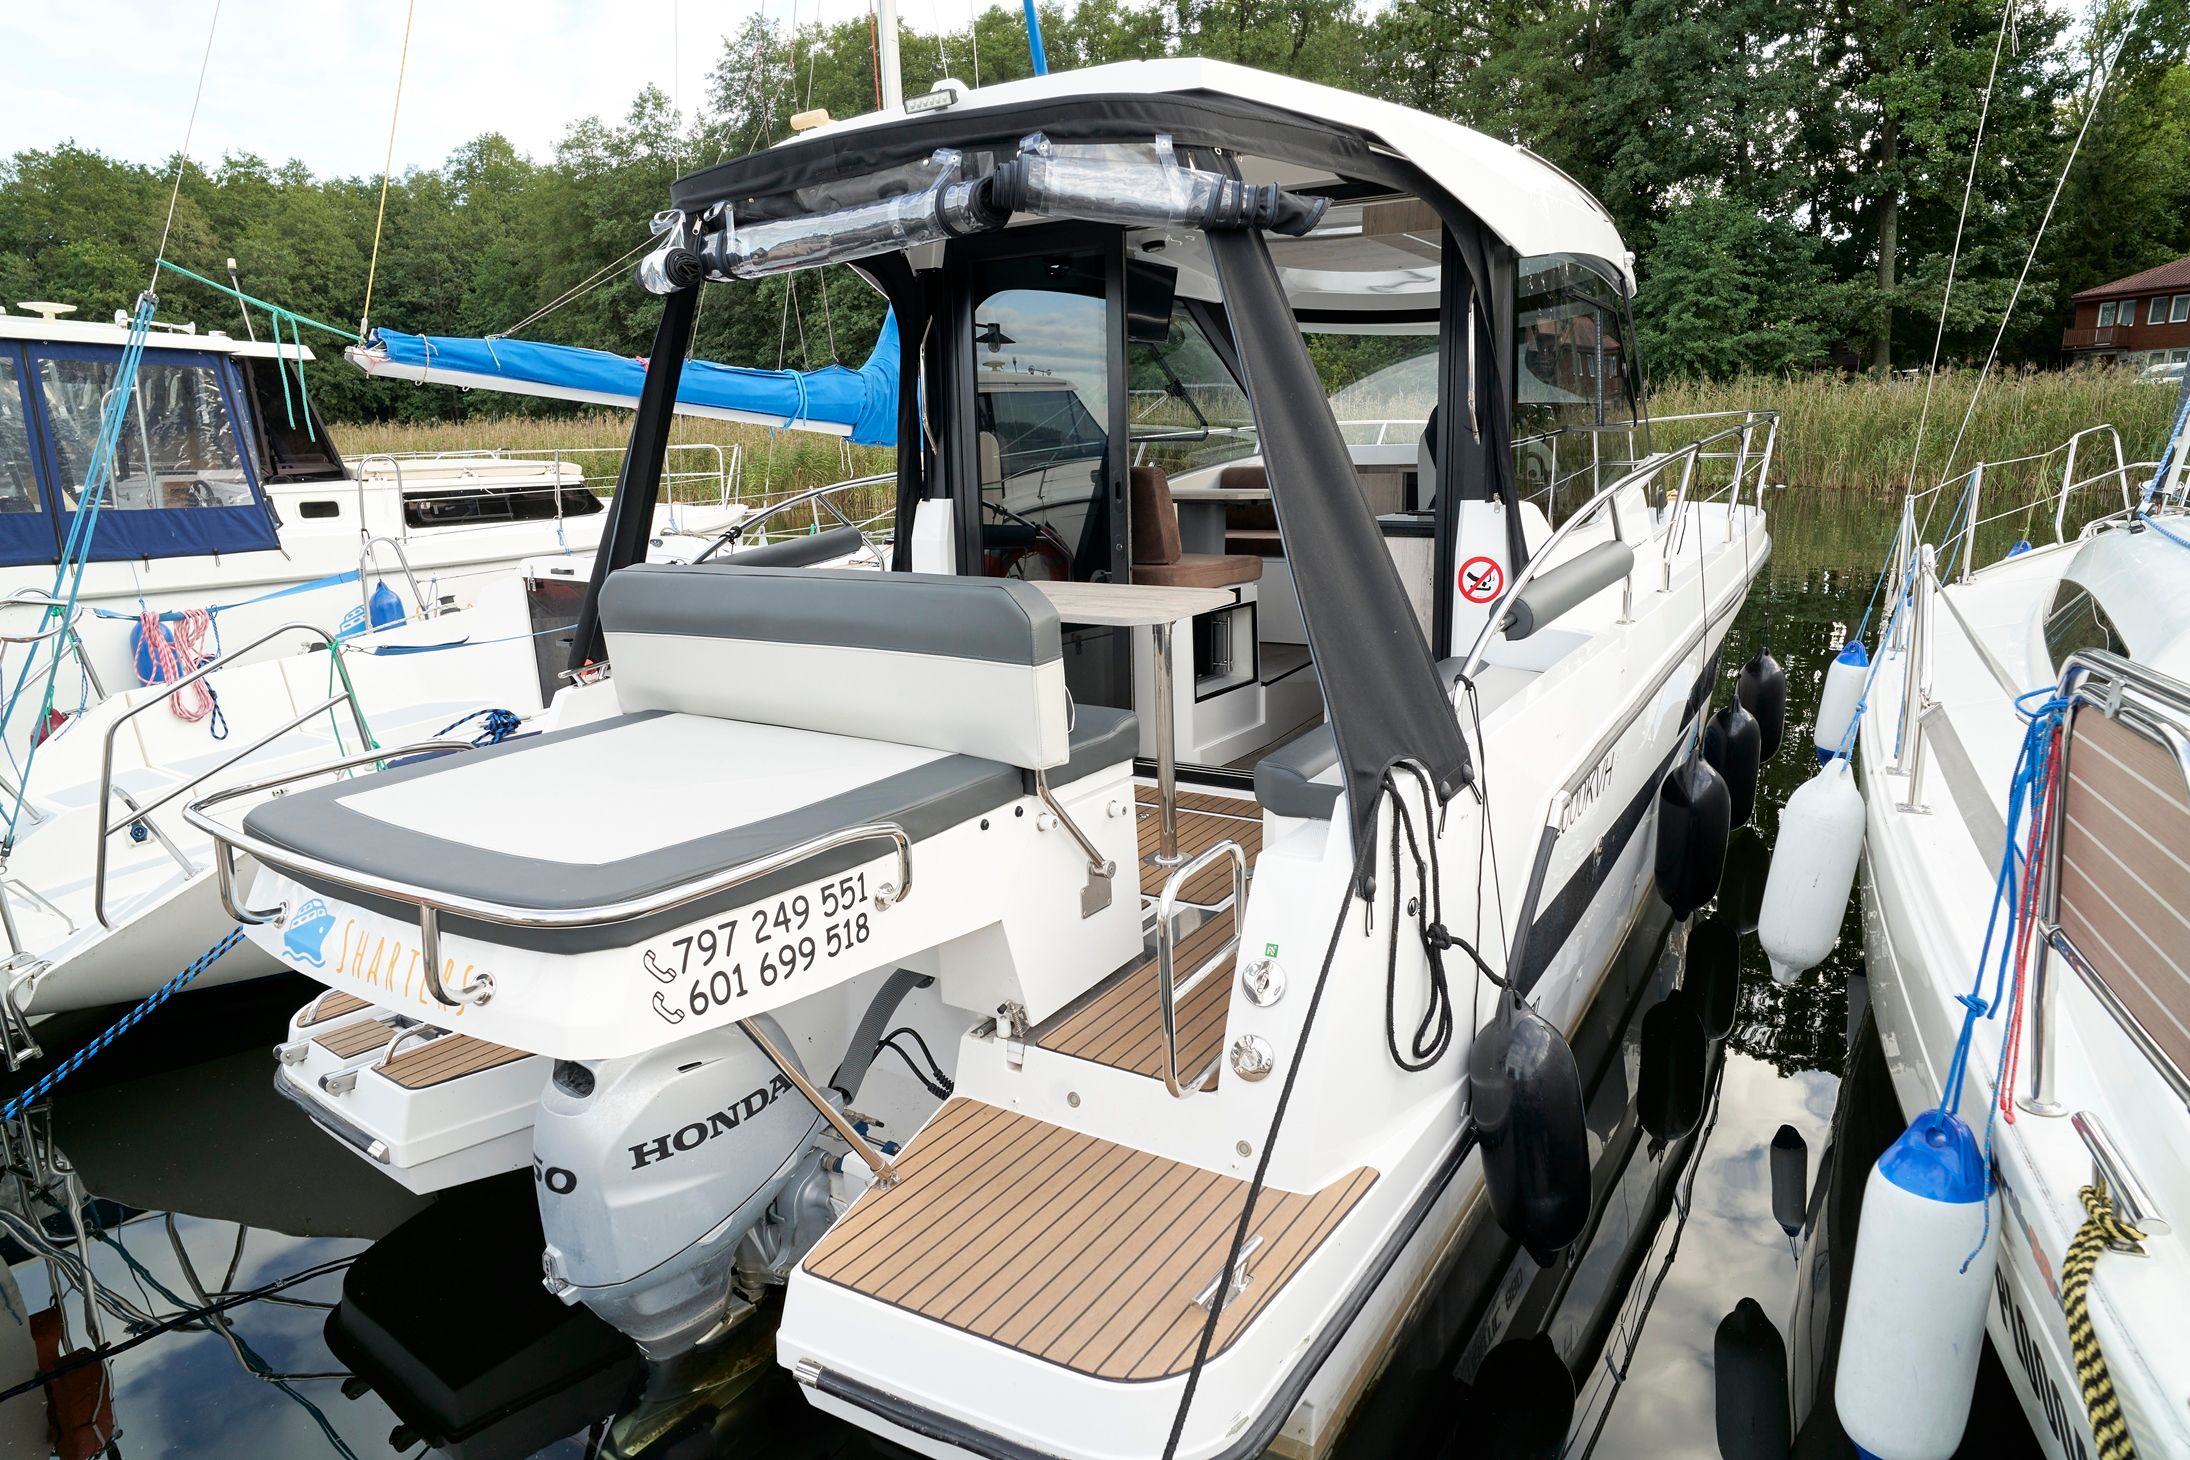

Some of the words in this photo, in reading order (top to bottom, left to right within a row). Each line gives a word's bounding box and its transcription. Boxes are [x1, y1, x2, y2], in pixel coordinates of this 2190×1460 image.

[672, 920, 738, 974] 797
[752, 895, 809, 944] 249
[820, 871, 868, 917] 551
[689, 963, 748, 1015] 601
[760, 937, 815, 986] 699
[826, 912, 870, 957] 518
[628, 1074, 793, 1170] HONDA
